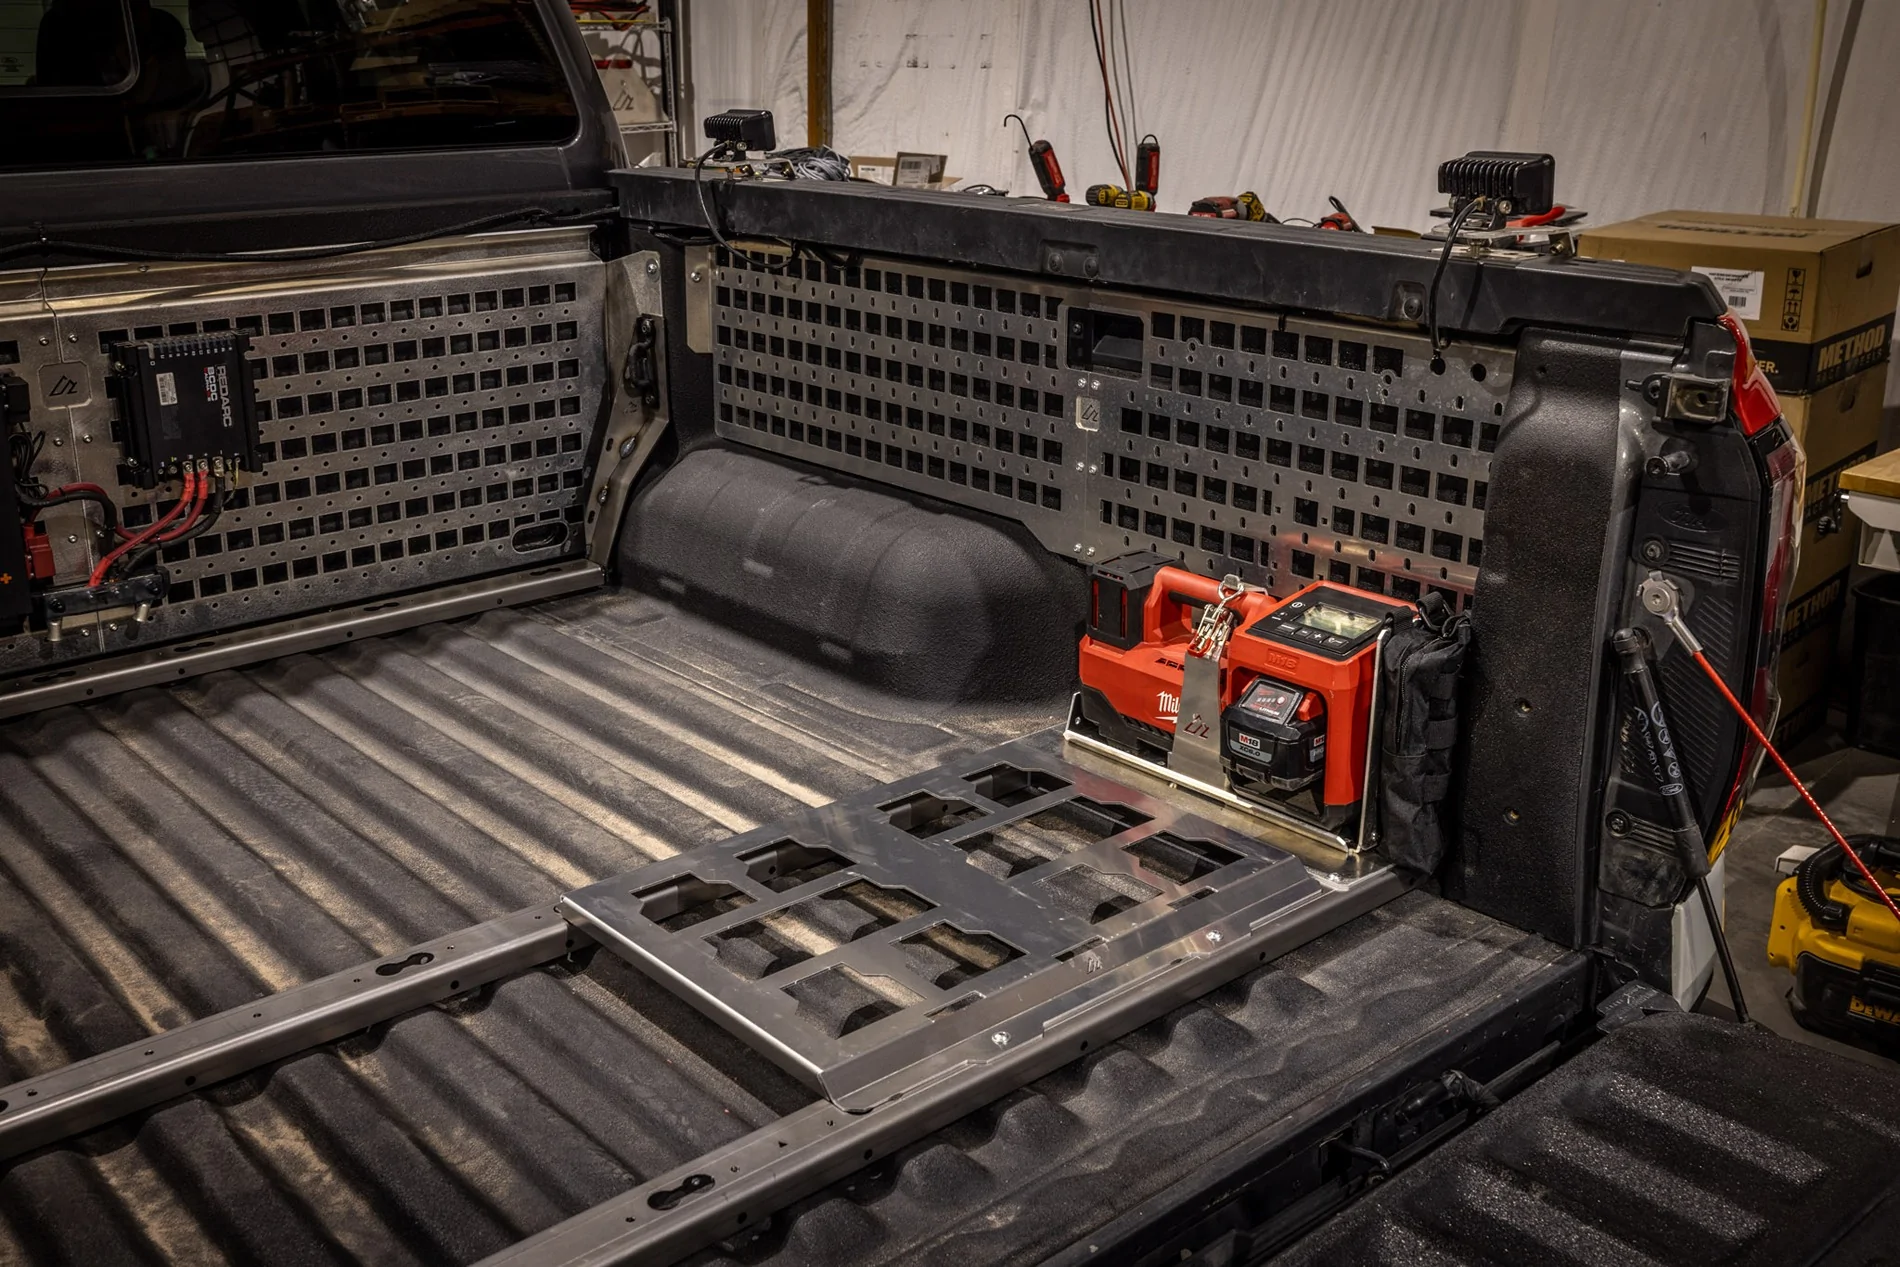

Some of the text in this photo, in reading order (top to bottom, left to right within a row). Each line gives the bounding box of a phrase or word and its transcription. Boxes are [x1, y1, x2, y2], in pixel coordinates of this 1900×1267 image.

[1818, 325, 1886, 371] METHOD
[1757, 360, 1779, 374] ER.
[207, 366, 218, 401] BCDC
[217, 366, 232, 427] REDARC
[1267, 652, 1297, 669] M18
[1156, 690, 1180, 714] Mil
[1240, 735, 1259, 747] M18
